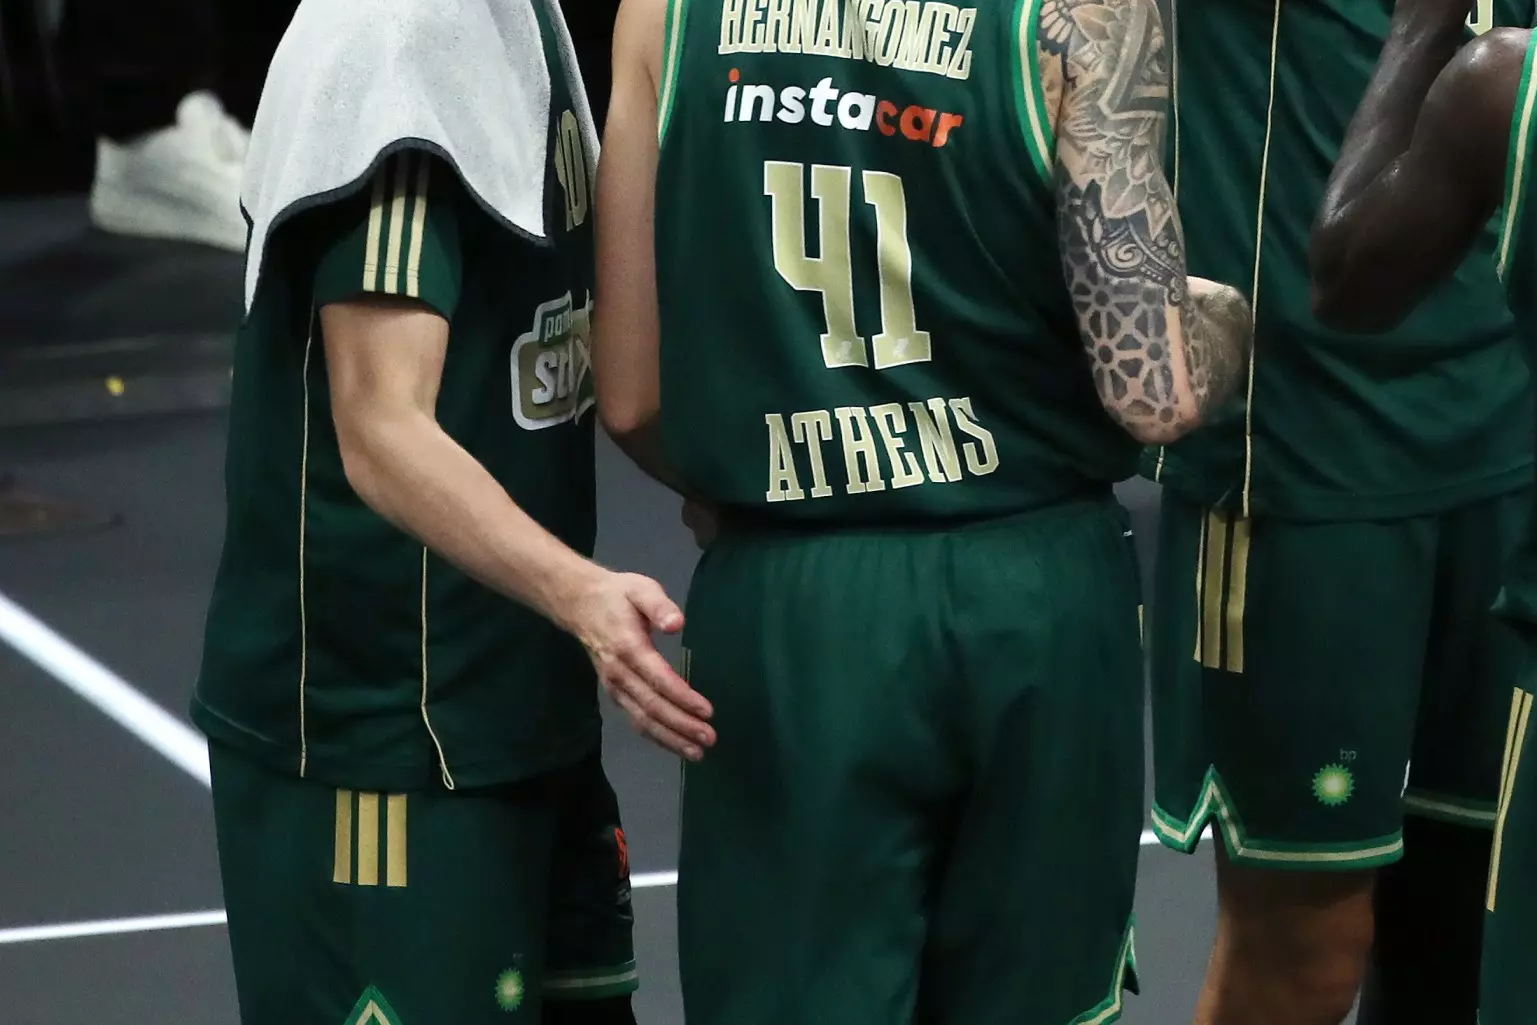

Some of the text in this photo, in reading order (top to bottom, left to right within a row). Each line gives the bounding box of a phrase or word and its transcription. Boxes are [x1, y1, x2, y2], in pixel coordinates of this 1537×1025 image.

[724, 68, 964, 148] instacar
[763, 160, 932, 370] 41
[764, 396, 1000, 503] ATHENS
